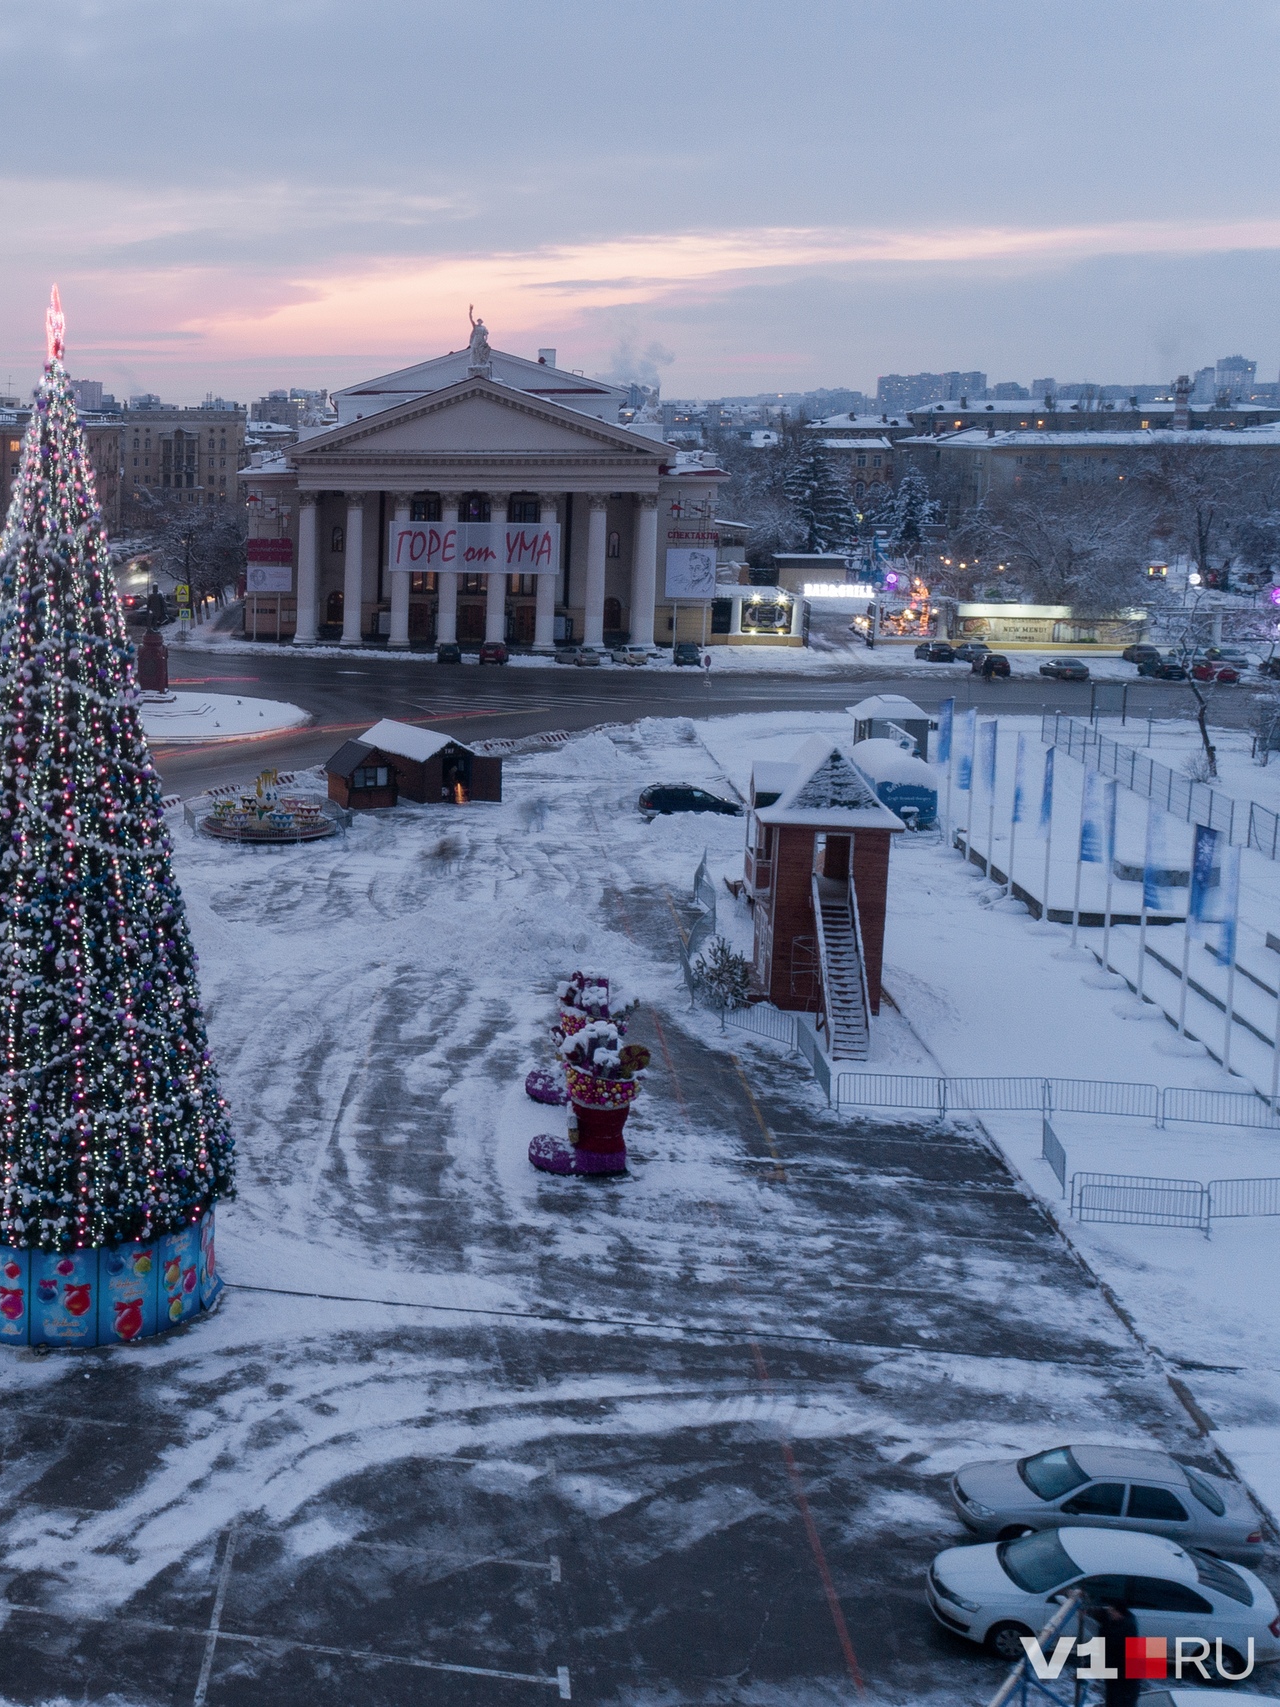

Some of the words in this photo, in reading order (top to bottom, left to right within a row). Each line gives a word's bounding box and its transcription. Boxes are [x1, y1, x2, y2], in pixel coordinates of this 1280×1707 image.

[396, 528, 458, 565] ГОРЕ
[505, 530, 552, 566] УМА
[666, 530, 719, 540] СПЕКТАКЛИ
